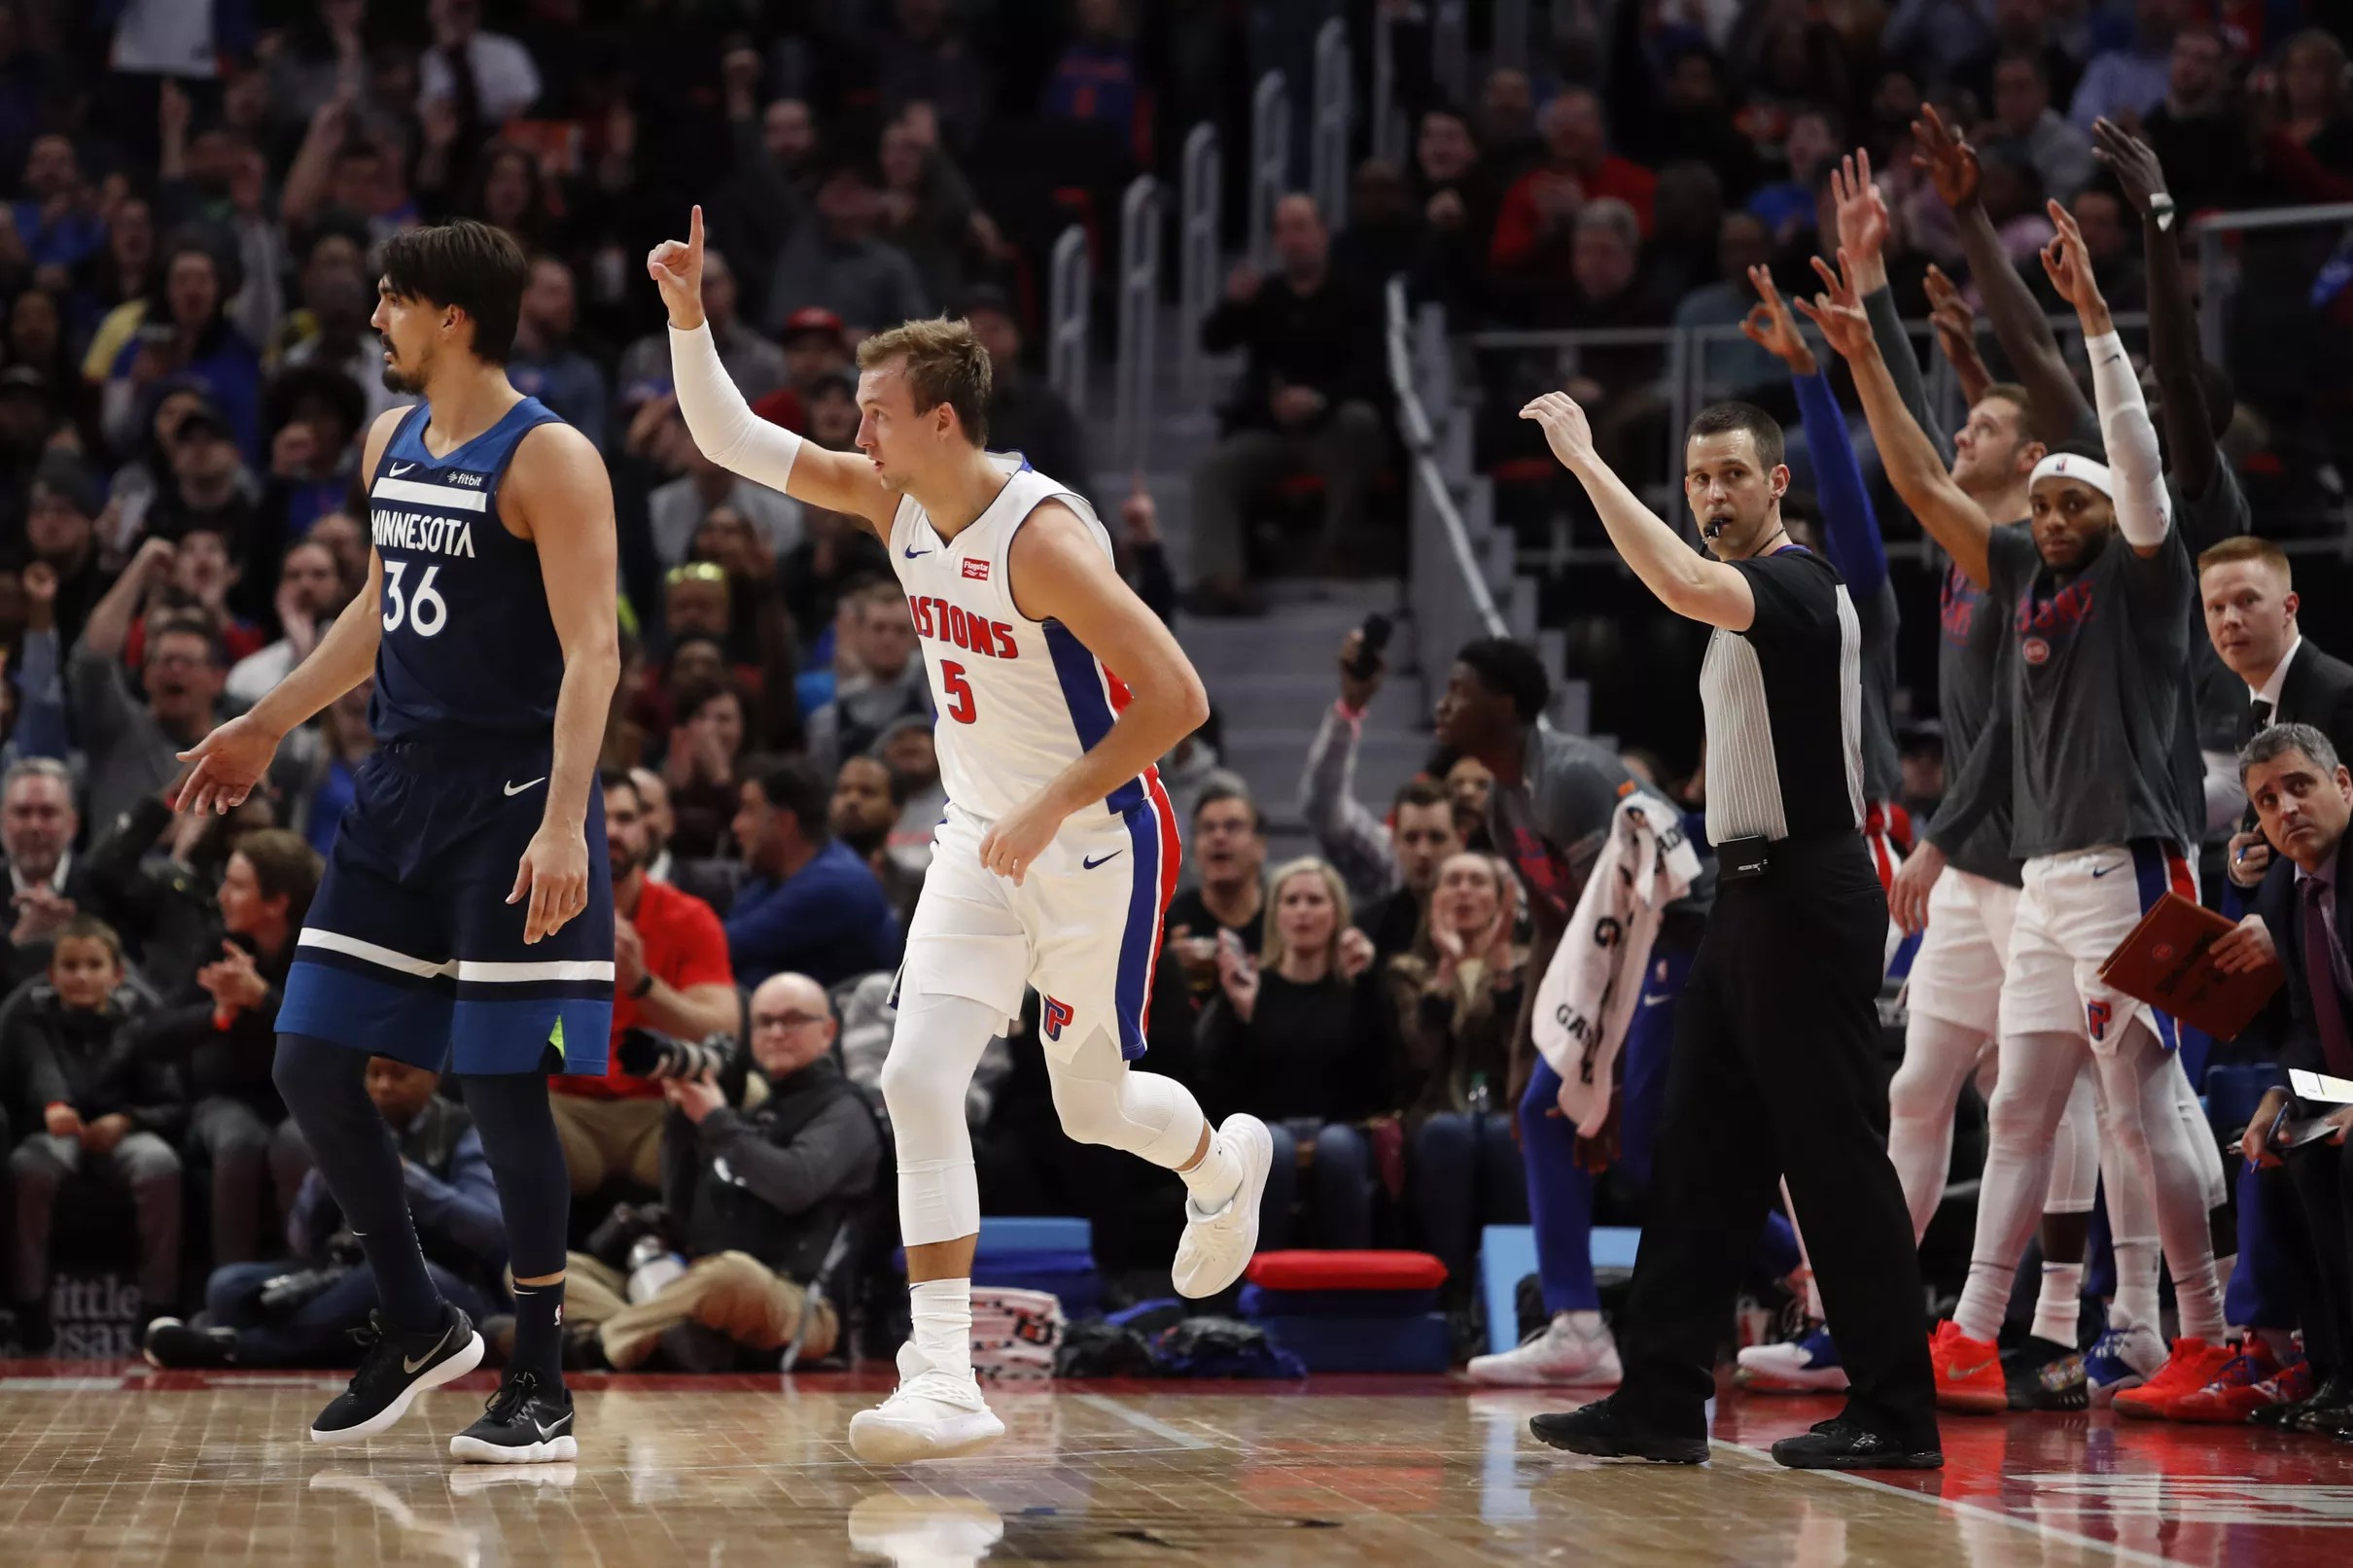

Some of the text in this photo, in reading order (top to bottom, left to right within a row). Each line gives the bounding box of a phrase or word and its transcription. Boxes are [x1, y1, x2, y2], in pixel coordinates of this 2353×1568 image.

[457, 472, 482, 487] fitbit
[370, 508, 475, 559] MINNESOTA
[382, 559, 447, 638] 36
[908, 595, 1019, 660] ISTONS
[940, 659, 977, 724] 5
[52, 1273, 143, 1318] ittle
